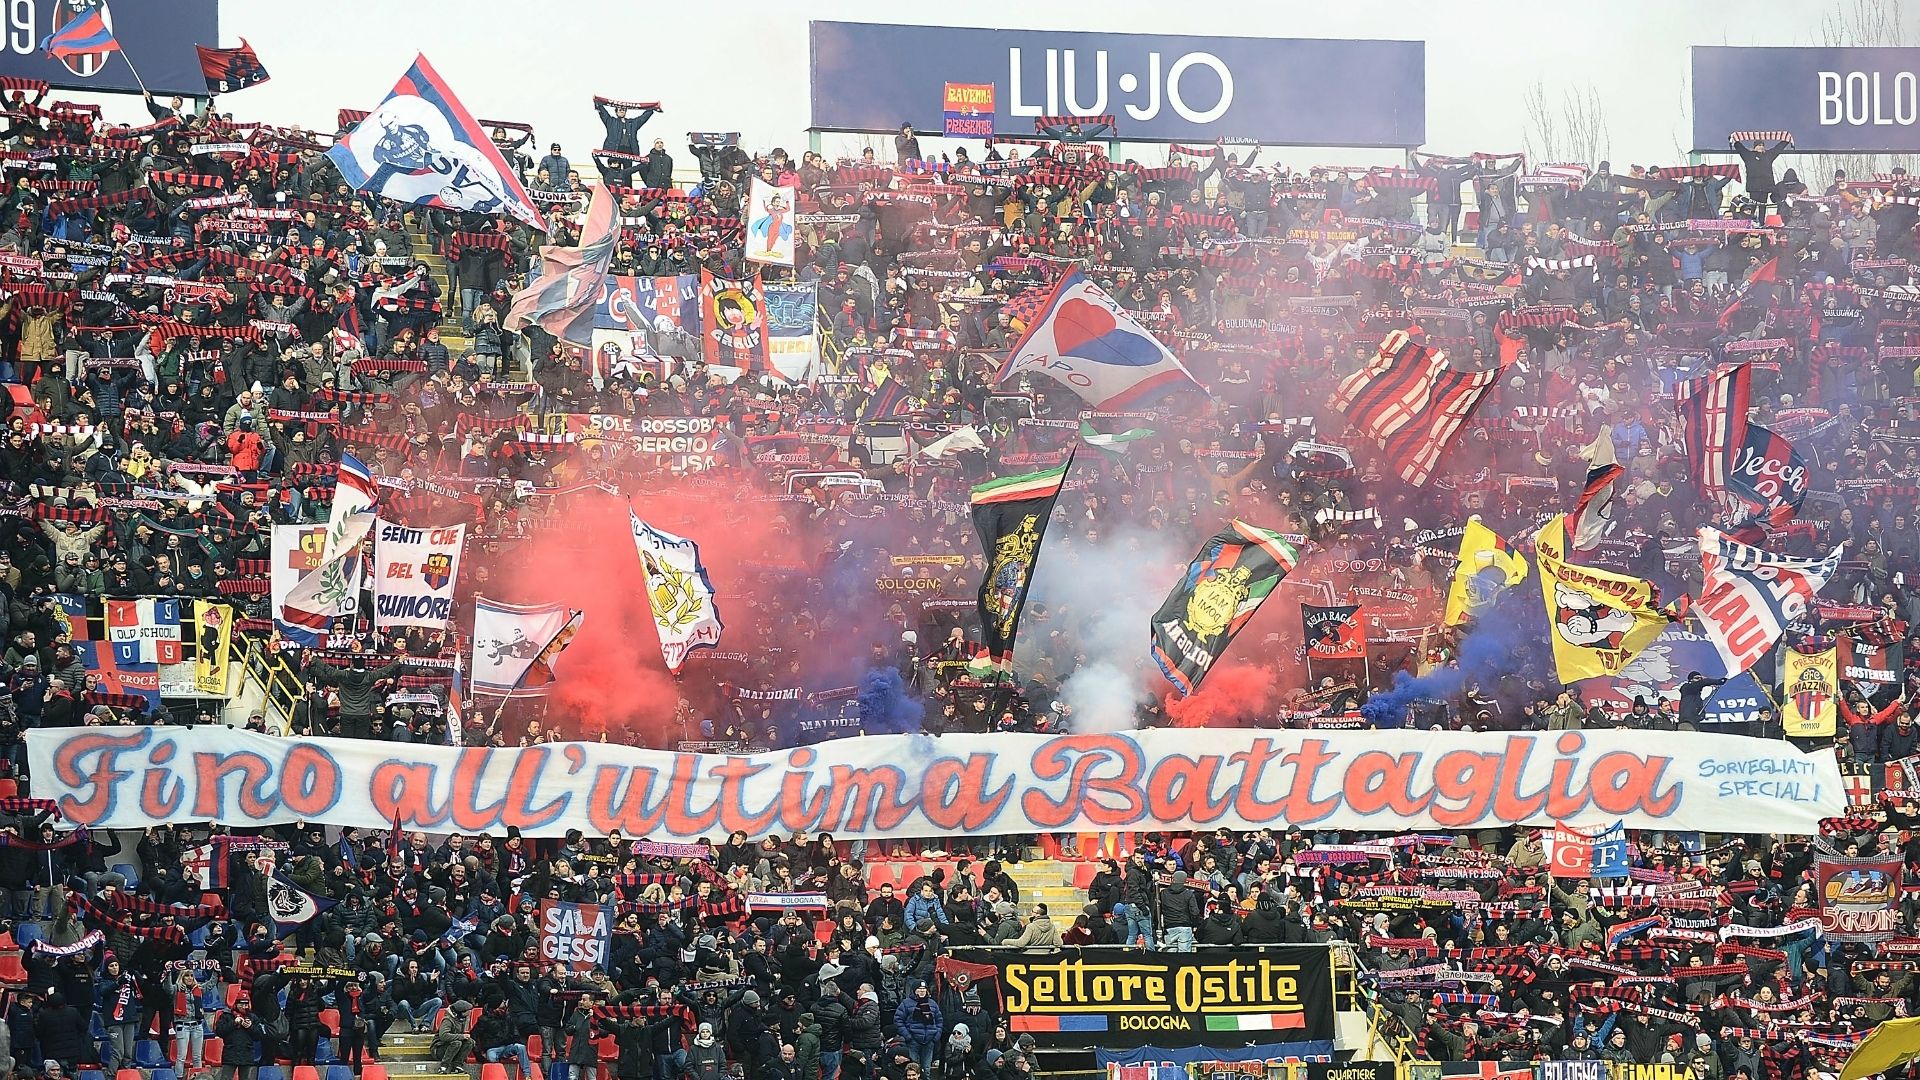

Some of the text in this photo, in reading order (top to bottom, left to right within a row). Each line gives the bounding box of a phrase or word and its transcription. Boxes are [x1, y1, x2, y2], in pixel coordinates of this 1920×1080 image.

[947, 86, 992, 104] RAVENNA
[527, 190, 567, 203] OLOGNA
[206, 221, 263, 231] FORZA BOLOGNA
[84, 240, 112, 252] NORD
[81, 289, 115, 302] BOLOGNA
[277, 409, 329, 420] FORZA RAGAZZI
[589, 415, 634, 433] SOLE
[629, 437, 708, 454] SERGIO
[381, 525, 457, 546] SENTI CHE
[301, 533, 326, 554] CT
[386, 562, 413, 579] BEL
[1324, 558, 1382, 572] 1909
[1353, 587, 1381, 597] FORZA
[377, 593, 452, 621] RUMORE
[1306, 611, 1327, 629] BELLA
[117, 628, 176, 641] OLD SCHOOL
[1310, 638, 1336, 654] GROUP
[1792, 655, 1832, 670] PRESENTI
[119, 673, 157, 687] CROCE
[1845, 665, 1897, 682] SOSTENERE
[738, 687, 800, 700] MAI DOMI
[1793, 681, 1829, 693] MAZZINI
[1718, 697, 1757, 708] 1974
[800, 719, 828, 731] MAI
[1699, 758, 1815, 778] SORVEGLIATI
[1841, 763, 1848, 775] B
[1853, 763, 1860, 775] F
[53, 727, 1683, 837] Fino all'ultima Battaglia
[1719, 779, 1822, 802] SPECIALI
[1555, 828, 1625, 846] BOLOGNA
[1434, 868, 1468, 878] BOLOGNA
[1469, 869, 1479, 878] FC
[1357, 887, 1397, 898] BOLOGNA
[1398, 887, 1408, 897] FC
[544, 907, 608, 937] SALA
[542, 935, 606, 966] GESSI
[283, 966, 356, 977] SORVEGLIATI SPECIALI
[1006, 958, 1300, 1012] Settore Ostile
[1120, 1016, 1190, 1031] BOLOGNA
[1647, 1007, 1696, 1027] BOLOGNA
[1202, 1062, 1263, 1078] PRIMA
[1326, 1068, 1376, 1080] QUARTIERE
[1544, 1061, 1598, 1080] BOLOGNA
